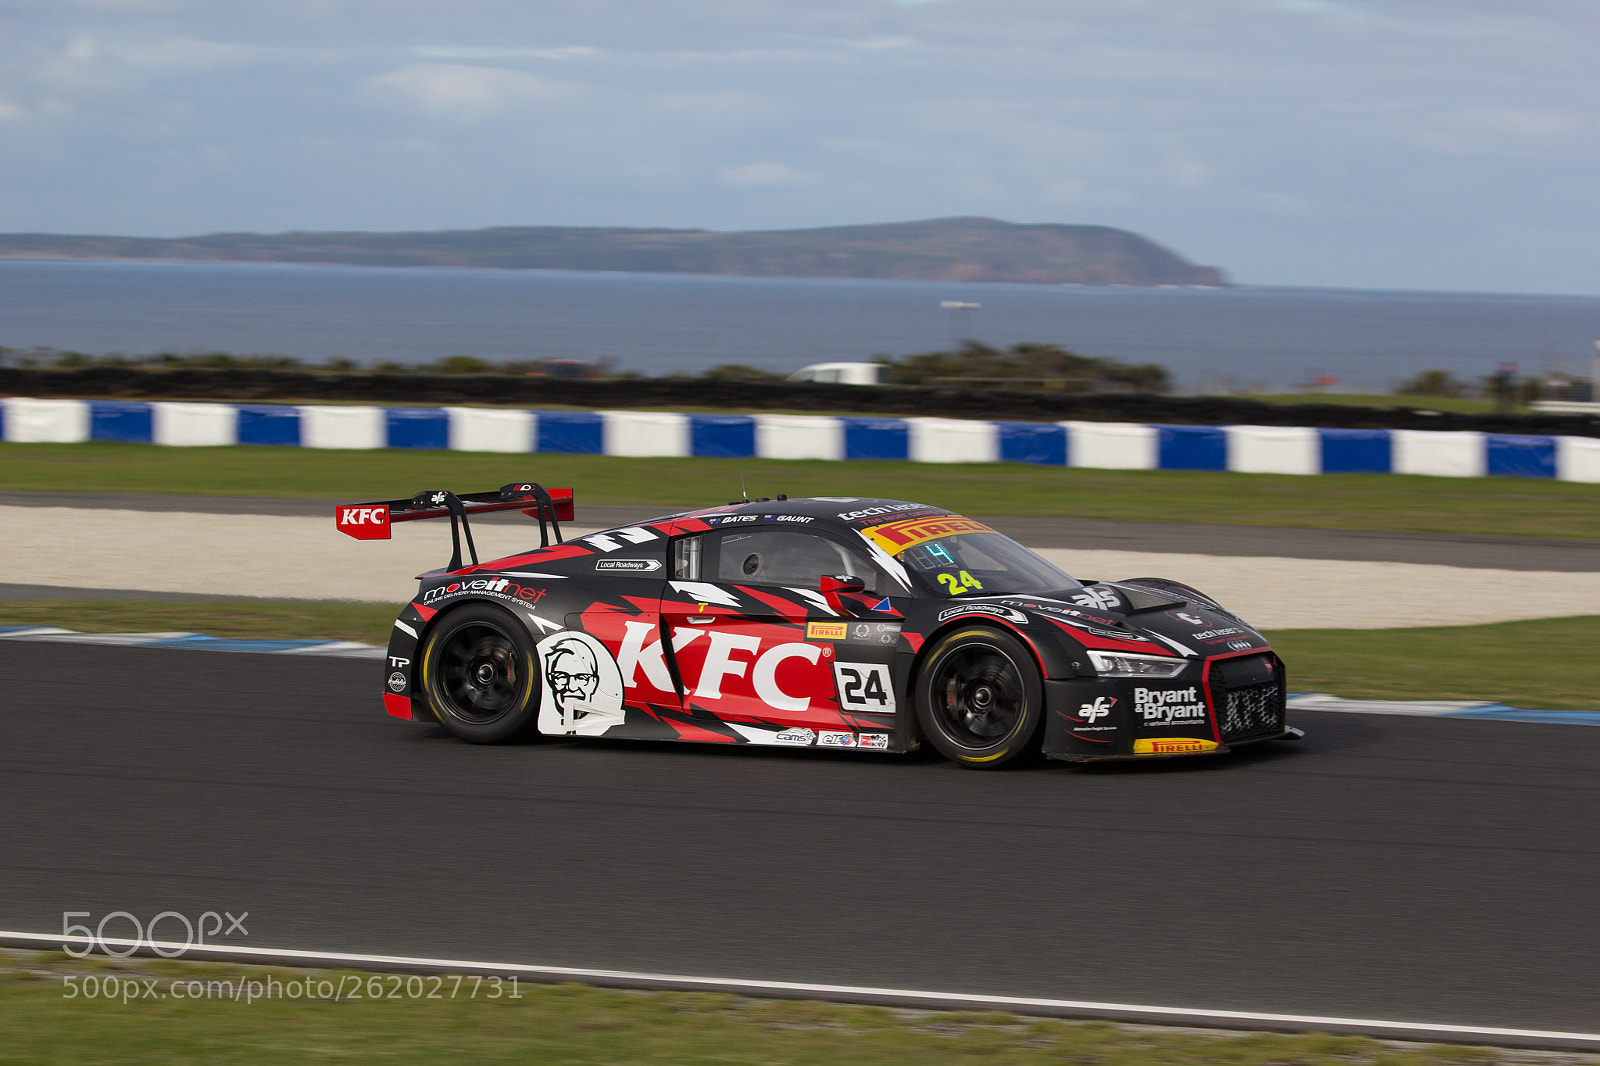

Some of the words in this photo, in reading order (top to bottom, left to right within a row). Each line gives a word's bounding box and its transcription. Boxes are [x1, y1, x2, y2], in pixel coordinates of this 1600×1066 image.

[340, 508, 386, 525] KFC
[722, 515, 757, 524] BATES
[776, 515, 814, 524] GAUNT
[837, 507, 892, 521] tech
[860, 517, 882, 526] The
[615, 561, 644, 570] Roadways
[937, 570, 983, 595] 24
[810, 624, 844, 636] PIRELLI
[388, 655, 410, 667] TP
[616, 621, 822, 711] KFC
[844, 667, 888, 705] 24
[1134, 687, 1197, 707] Bryant
[1078, 697, 1111, 724] afs
[1134, 704, 1144, 713] &
[1143, 702, 1206, 721] Bryant
[1152, 741, 1202, 752] PIRELLI
